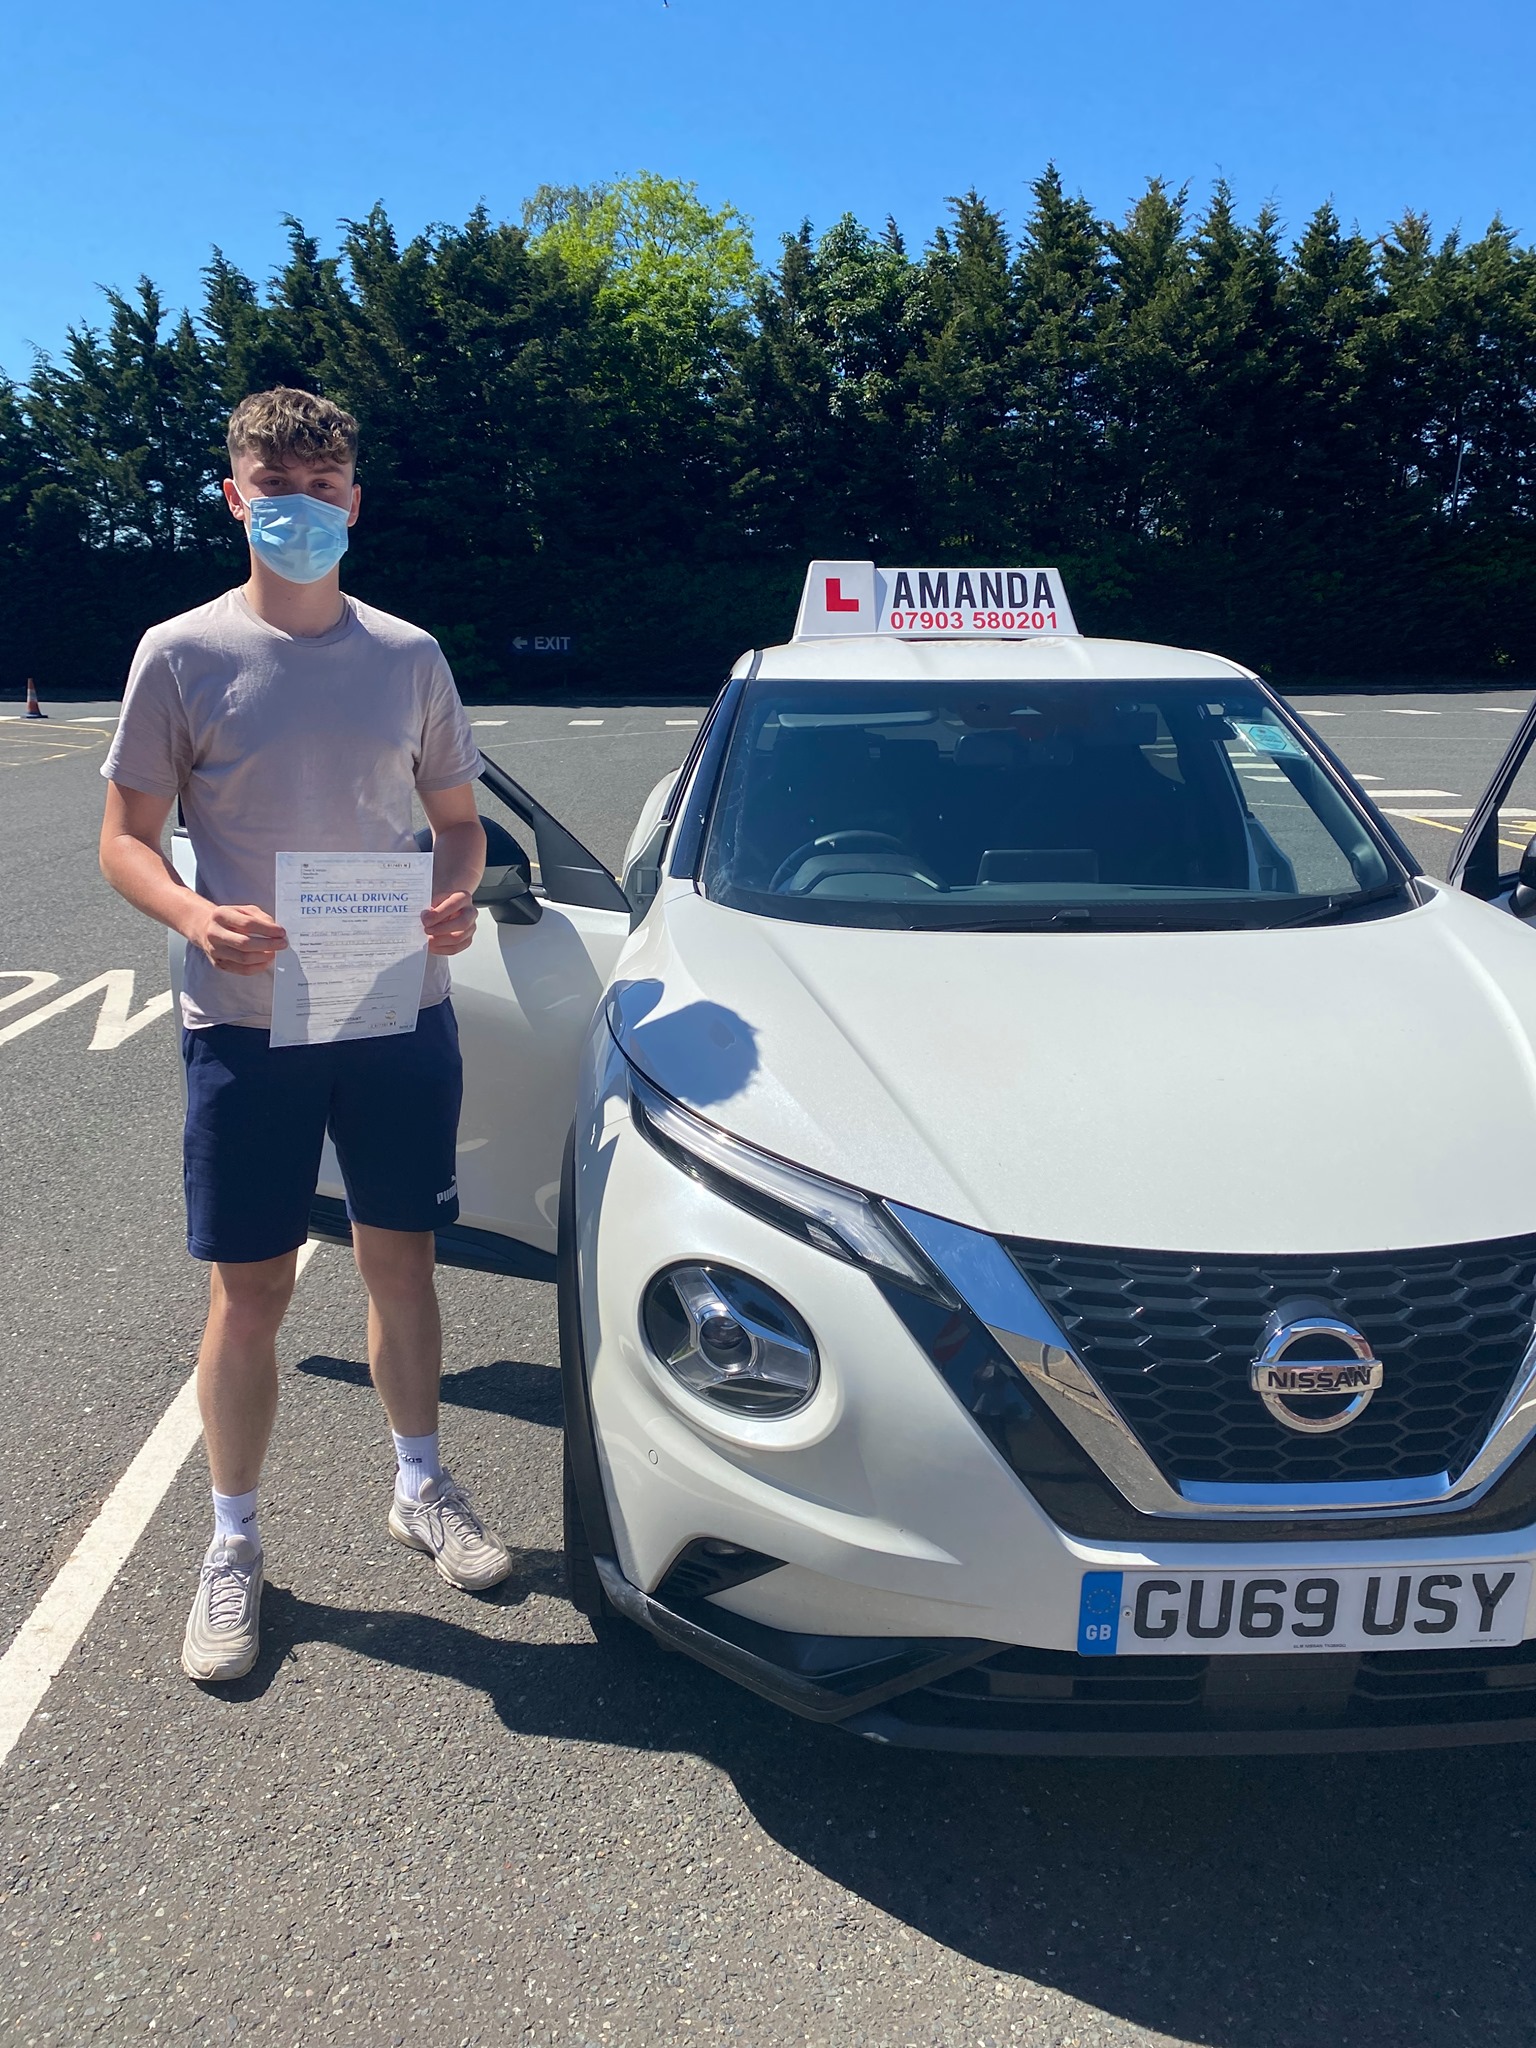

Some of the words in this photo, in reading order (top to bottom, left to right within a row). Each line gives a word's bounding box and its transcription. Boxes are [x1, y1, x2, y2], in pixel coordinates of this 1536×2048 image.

[825, 578, 860, 612] L
[892, 572, 1056, 609] AMANDA
[890, 611, 964, 630] 07903
[972, 611, 1058, 630] 580201
[534, 636, 571, 650] EXIT
[300, 893, 358, 903] PRACTICAL
[362, 892, 409, 902] DRIVING
[301, 906, 322, 915] TEST
[325, 905, 348, 914] PASS
[350, 904, 409, 914] CERTIFICATE
[436, 1185, 457, 1205] PUM
[1268, 1370, 1371, 1388] NISSAN
[1133, 1577, 1340, 1639] GU69
[1361, 1572, 1516, 1636] USY
[1085, 1624, 1111, 1641] GB
